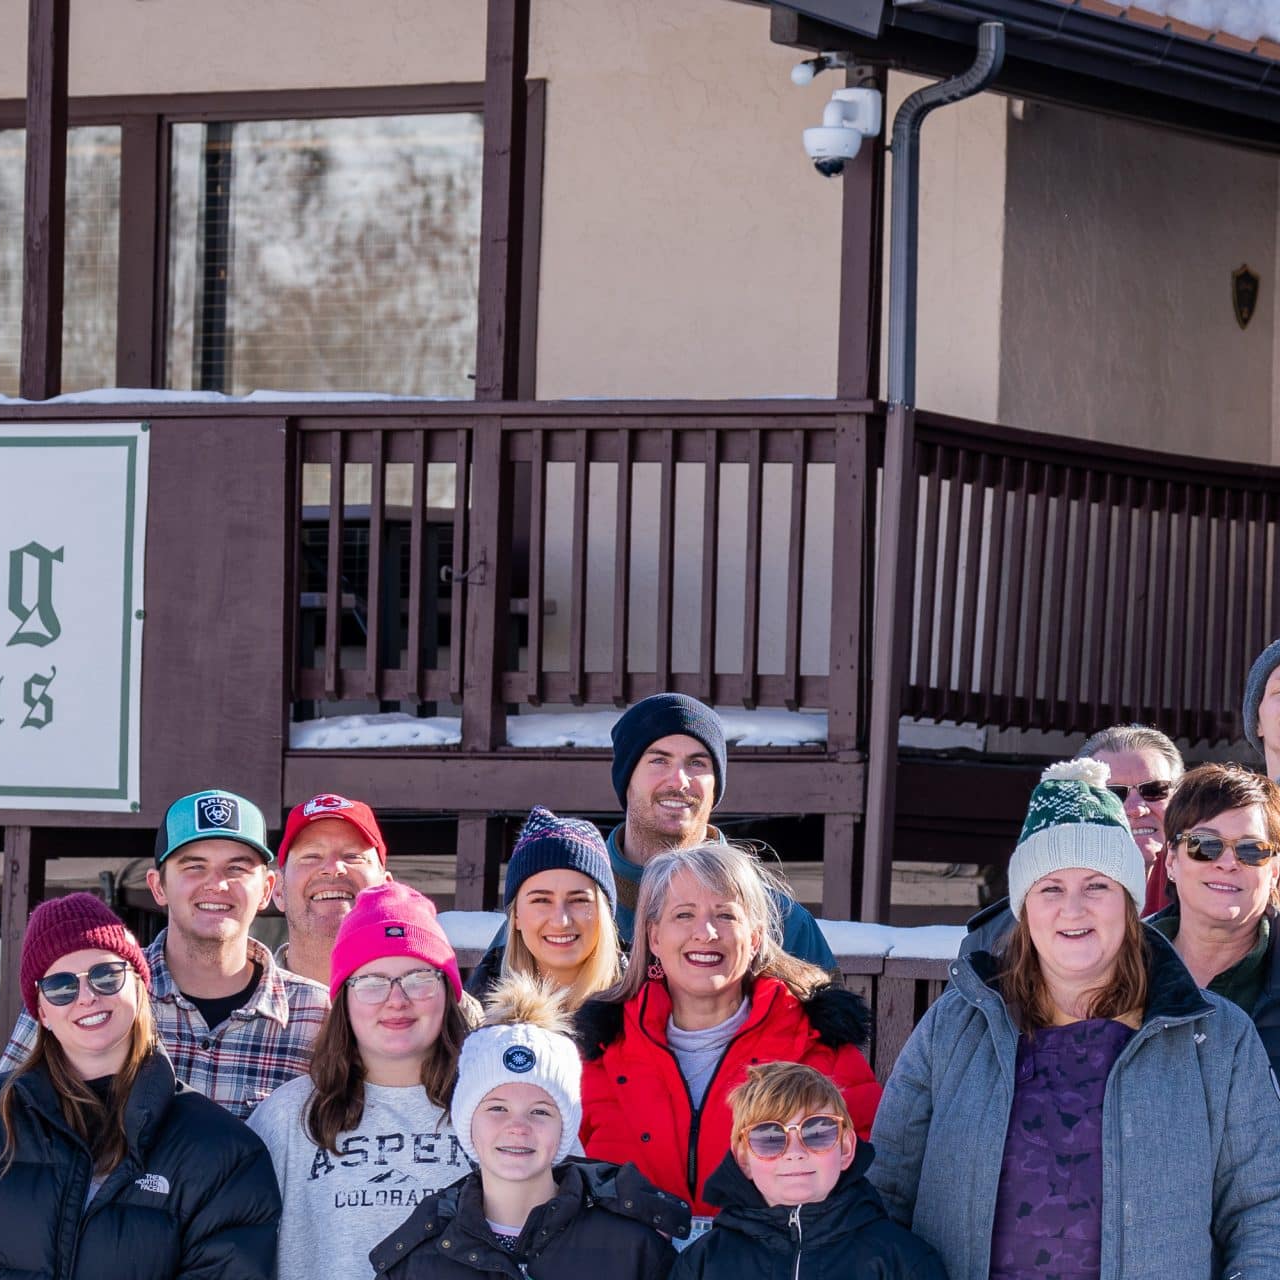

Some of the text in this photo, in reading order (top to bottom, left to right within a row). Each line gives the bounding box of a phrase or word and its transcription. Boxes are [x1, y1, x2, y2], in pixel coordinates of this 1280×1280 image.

[200, 798, 236, 808] ARIAT
[307, 1133, 479, 1181] ASPEN
[140, 1184, 160, 1192] FACE
[334, 1188, 445, 1209] COLORA
